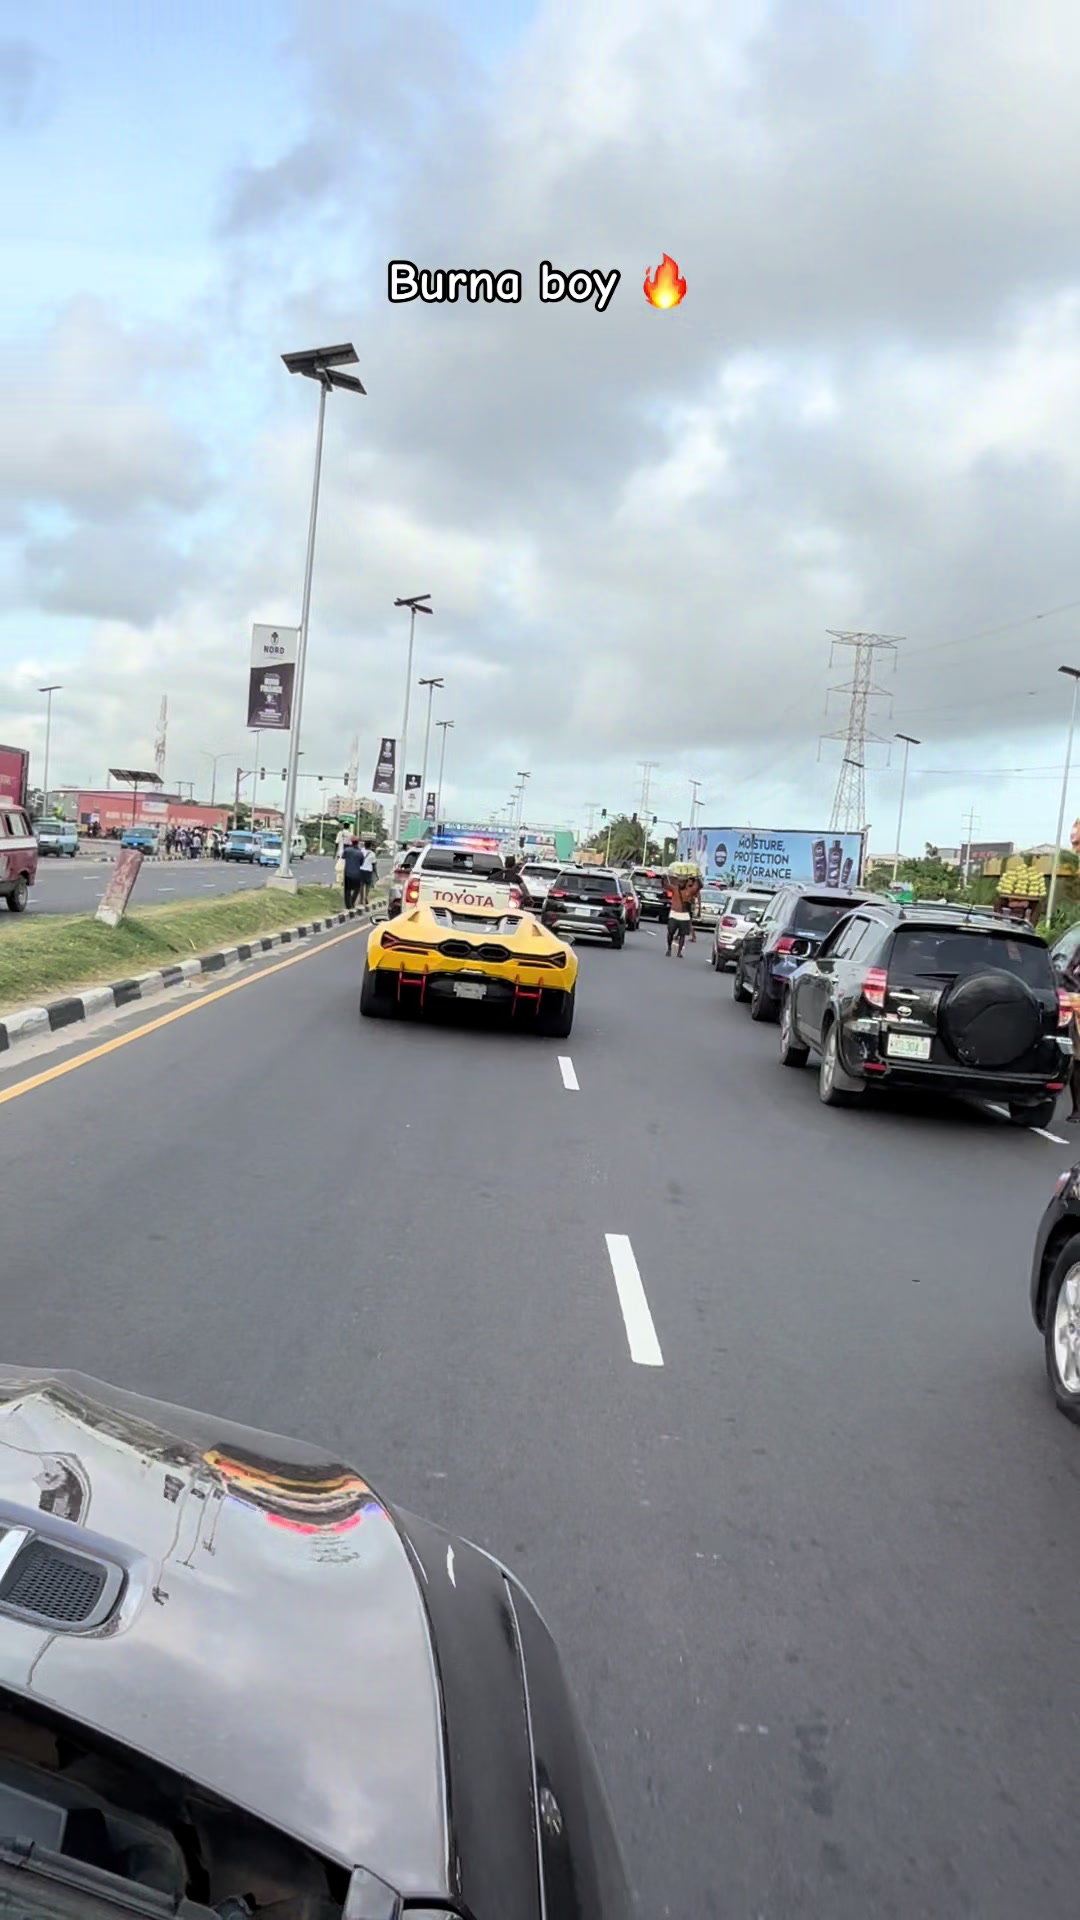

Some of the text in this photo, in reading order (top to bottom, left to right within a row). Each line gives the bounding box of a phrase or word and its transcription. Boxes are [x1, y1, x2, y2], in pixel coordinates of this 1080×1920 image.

[263, 645, 285, 654] NORD
[734, 851, 789, 865] PROTECTION
[737, 865, 791, 879] FRAGRANCE
[433, 891, 494, 907] TOYOTA
